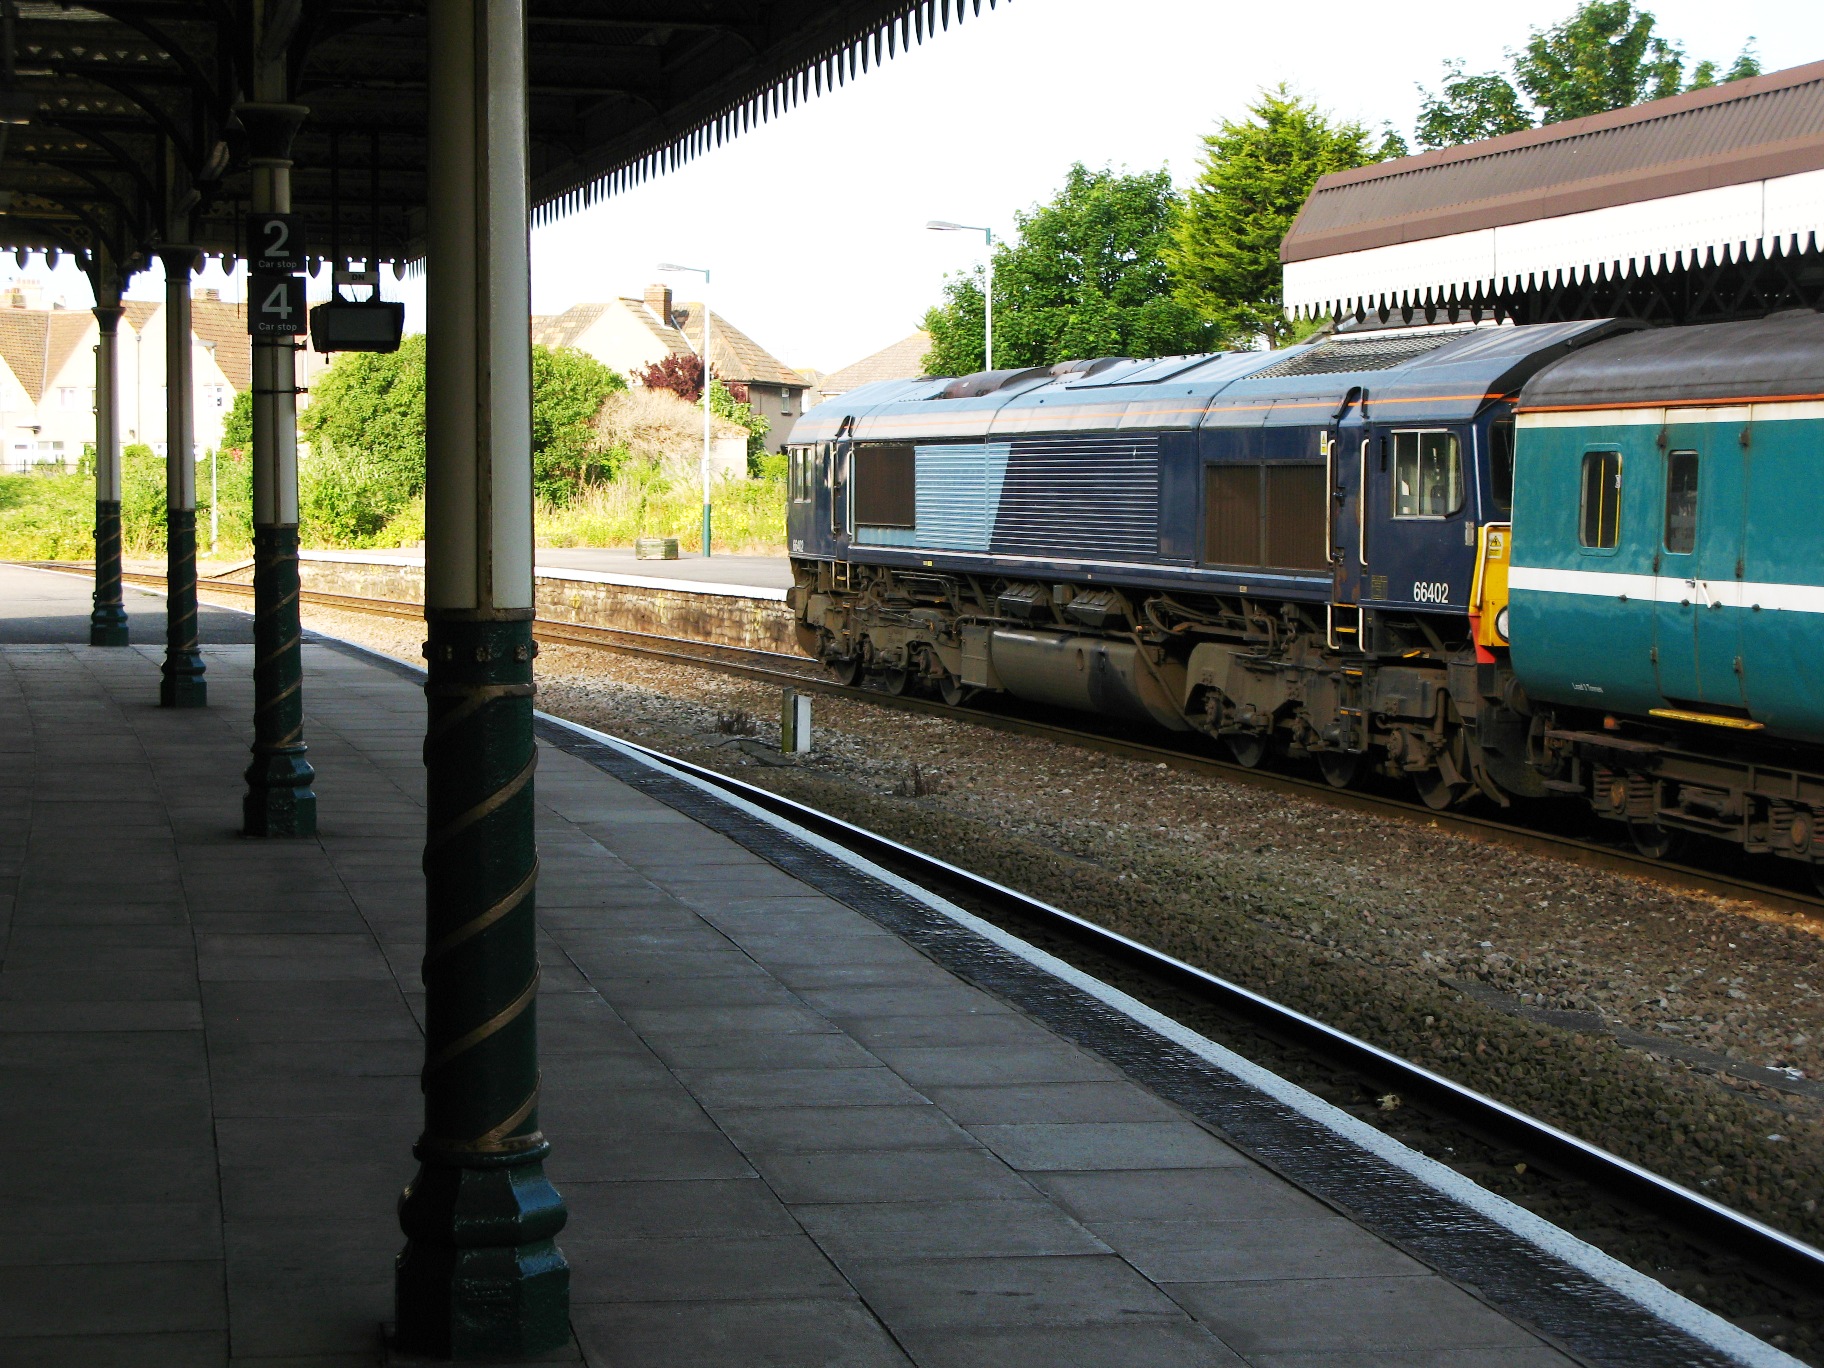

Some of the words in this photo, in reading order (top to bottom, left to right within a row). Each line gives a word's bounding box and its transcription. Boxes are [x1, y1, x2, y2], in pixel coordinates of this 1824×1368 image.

[264, 221, 289, 257] 2
[258, 260, 274, 268] Car
[277, 260, 297, 269] stop
[351, 273, 365, 281] DN
[262, 283, 292, 319] 4
[258, 322, 275, 331] Car
[277, 323, 297, 332] stop
[1413, 581, 1449, 603] 66402
